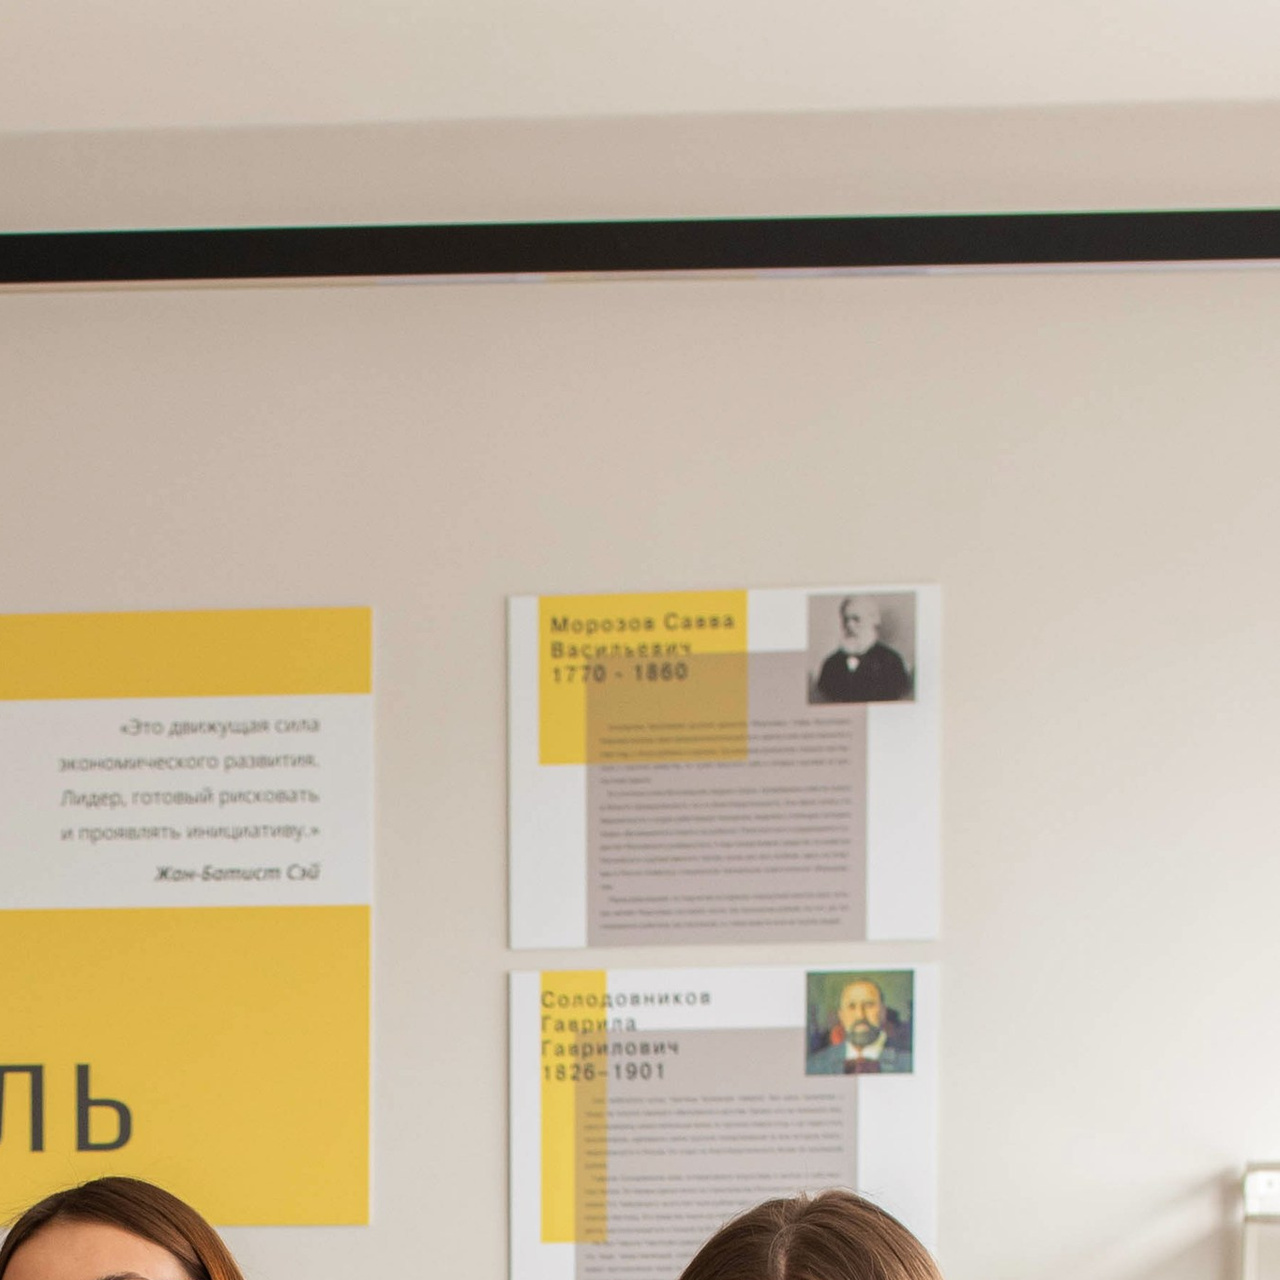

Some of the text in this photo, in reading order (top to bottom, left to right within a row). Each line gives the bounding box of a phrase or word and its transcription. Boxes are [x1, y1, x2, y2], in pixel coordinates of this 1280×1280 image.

[553, 664, 606, 682] 1770
[168, 717, 269, 738] движущая
[275, 718, 320, 733] сила
[58, 754, 219, 772] экономического
[60, 786, 320, 808] Лидер, готовый рисковать
[60, 826, 74, 840] и
[78, 825, 180, 845] проявлять
[154, 861, 320, 881] Жан-Батист Сэй
[541, 991, 711, 1008] Солодовников
[541, 1016, 637, 1034] Гаврила
[541, 1039, 680, 1058] Гаврилович
